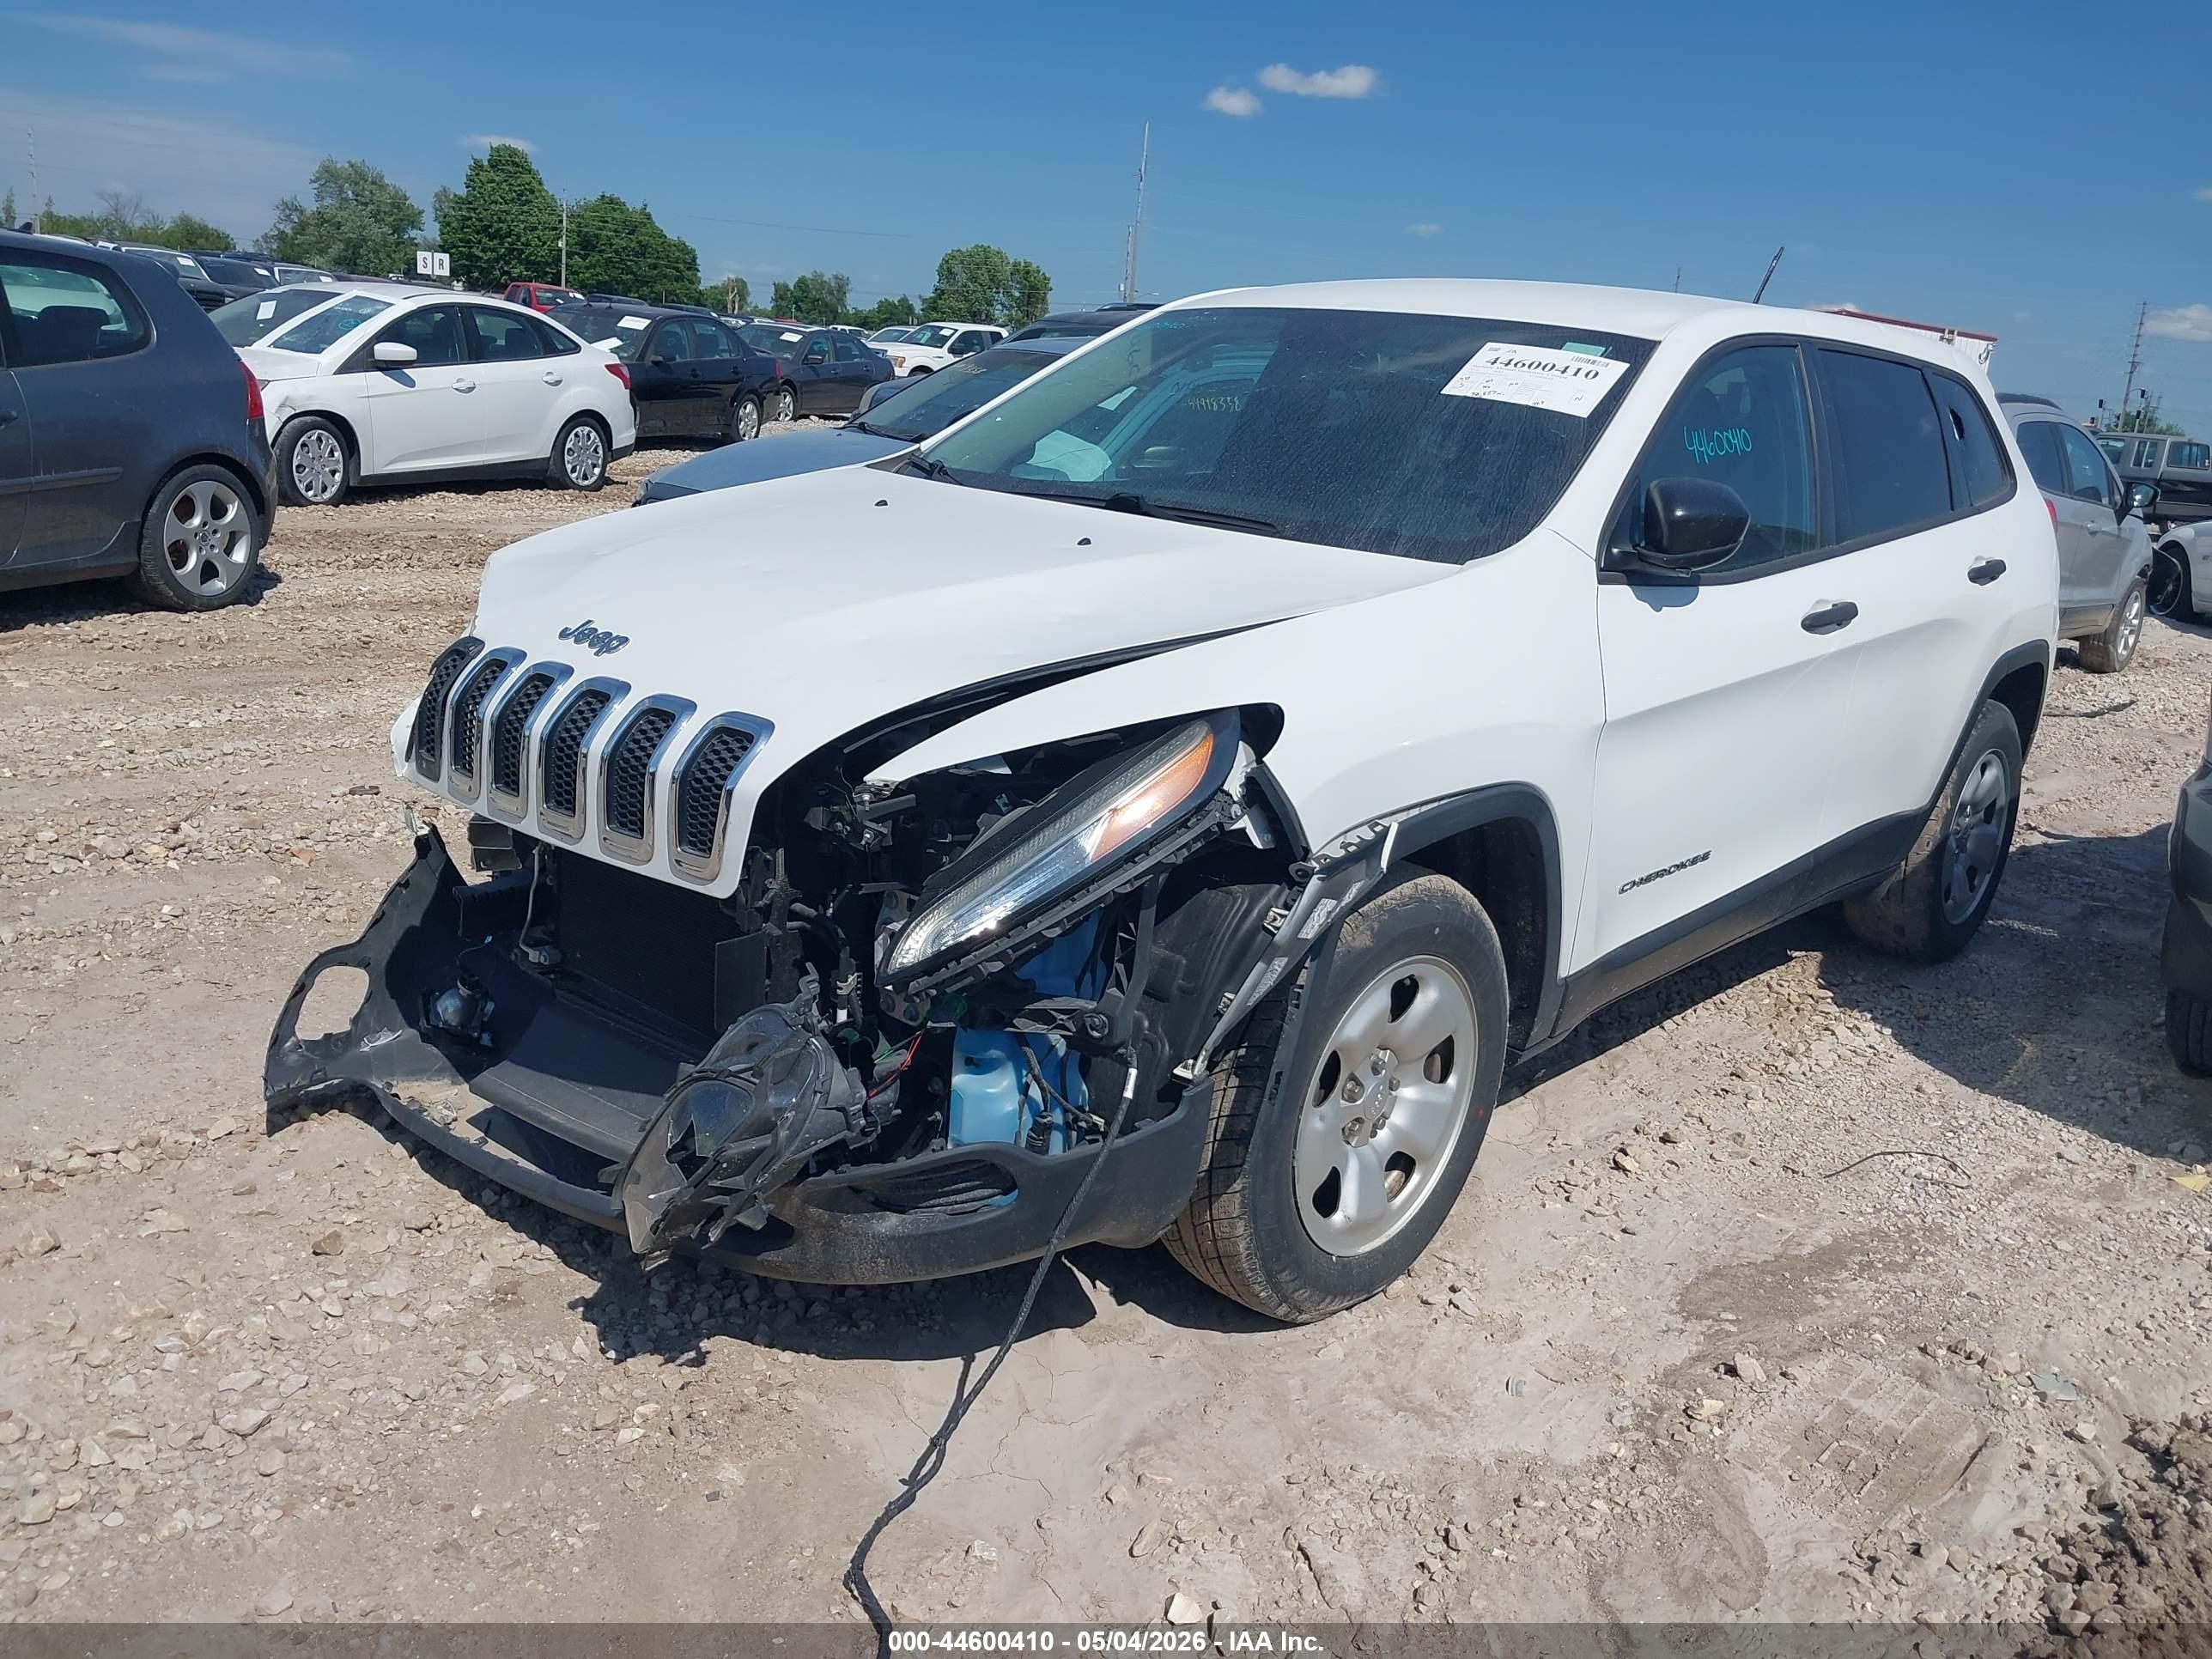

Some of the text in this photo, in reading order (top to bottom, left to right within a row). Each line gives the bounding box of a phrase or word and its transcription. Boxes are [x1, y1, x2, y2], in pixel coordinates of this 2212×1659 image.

[422, 257, 445, 270] S R
[1485, 356, 1601, 381] 44600410
[1683, 425, 1753, 465] 44600410
[557, 618, 631, 658] Jeep
[1618, 849, 1712, 895] CHEROKEE
